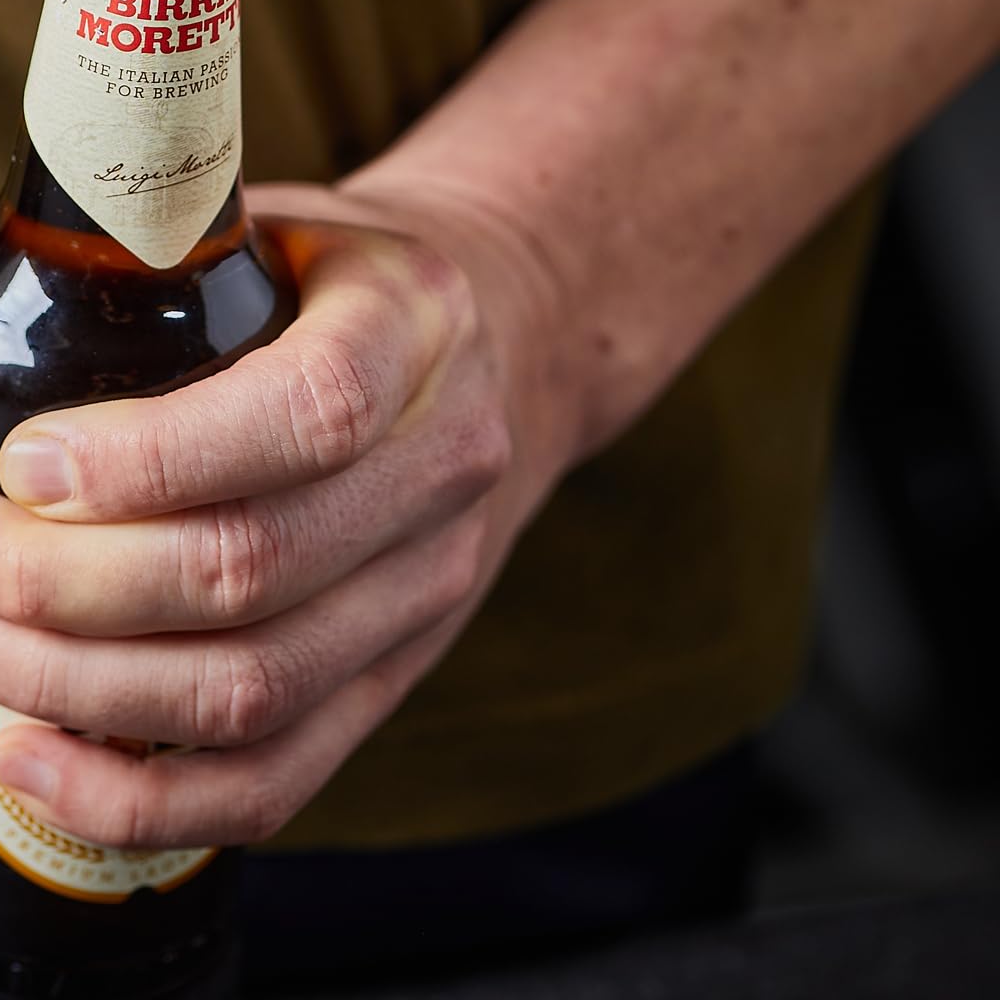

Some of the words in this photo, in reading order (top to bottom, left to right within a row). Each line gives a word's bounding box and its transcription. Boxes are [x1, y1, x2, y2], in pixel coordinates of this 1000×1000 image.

[78, 54, 112, 77] THE
[118, 67, 195, 84] ITALIAN
[105, 81, 145, 99] FOR
[153, 68, 229, 100] BREWING
[93, 163, 165, 194] Luigi
